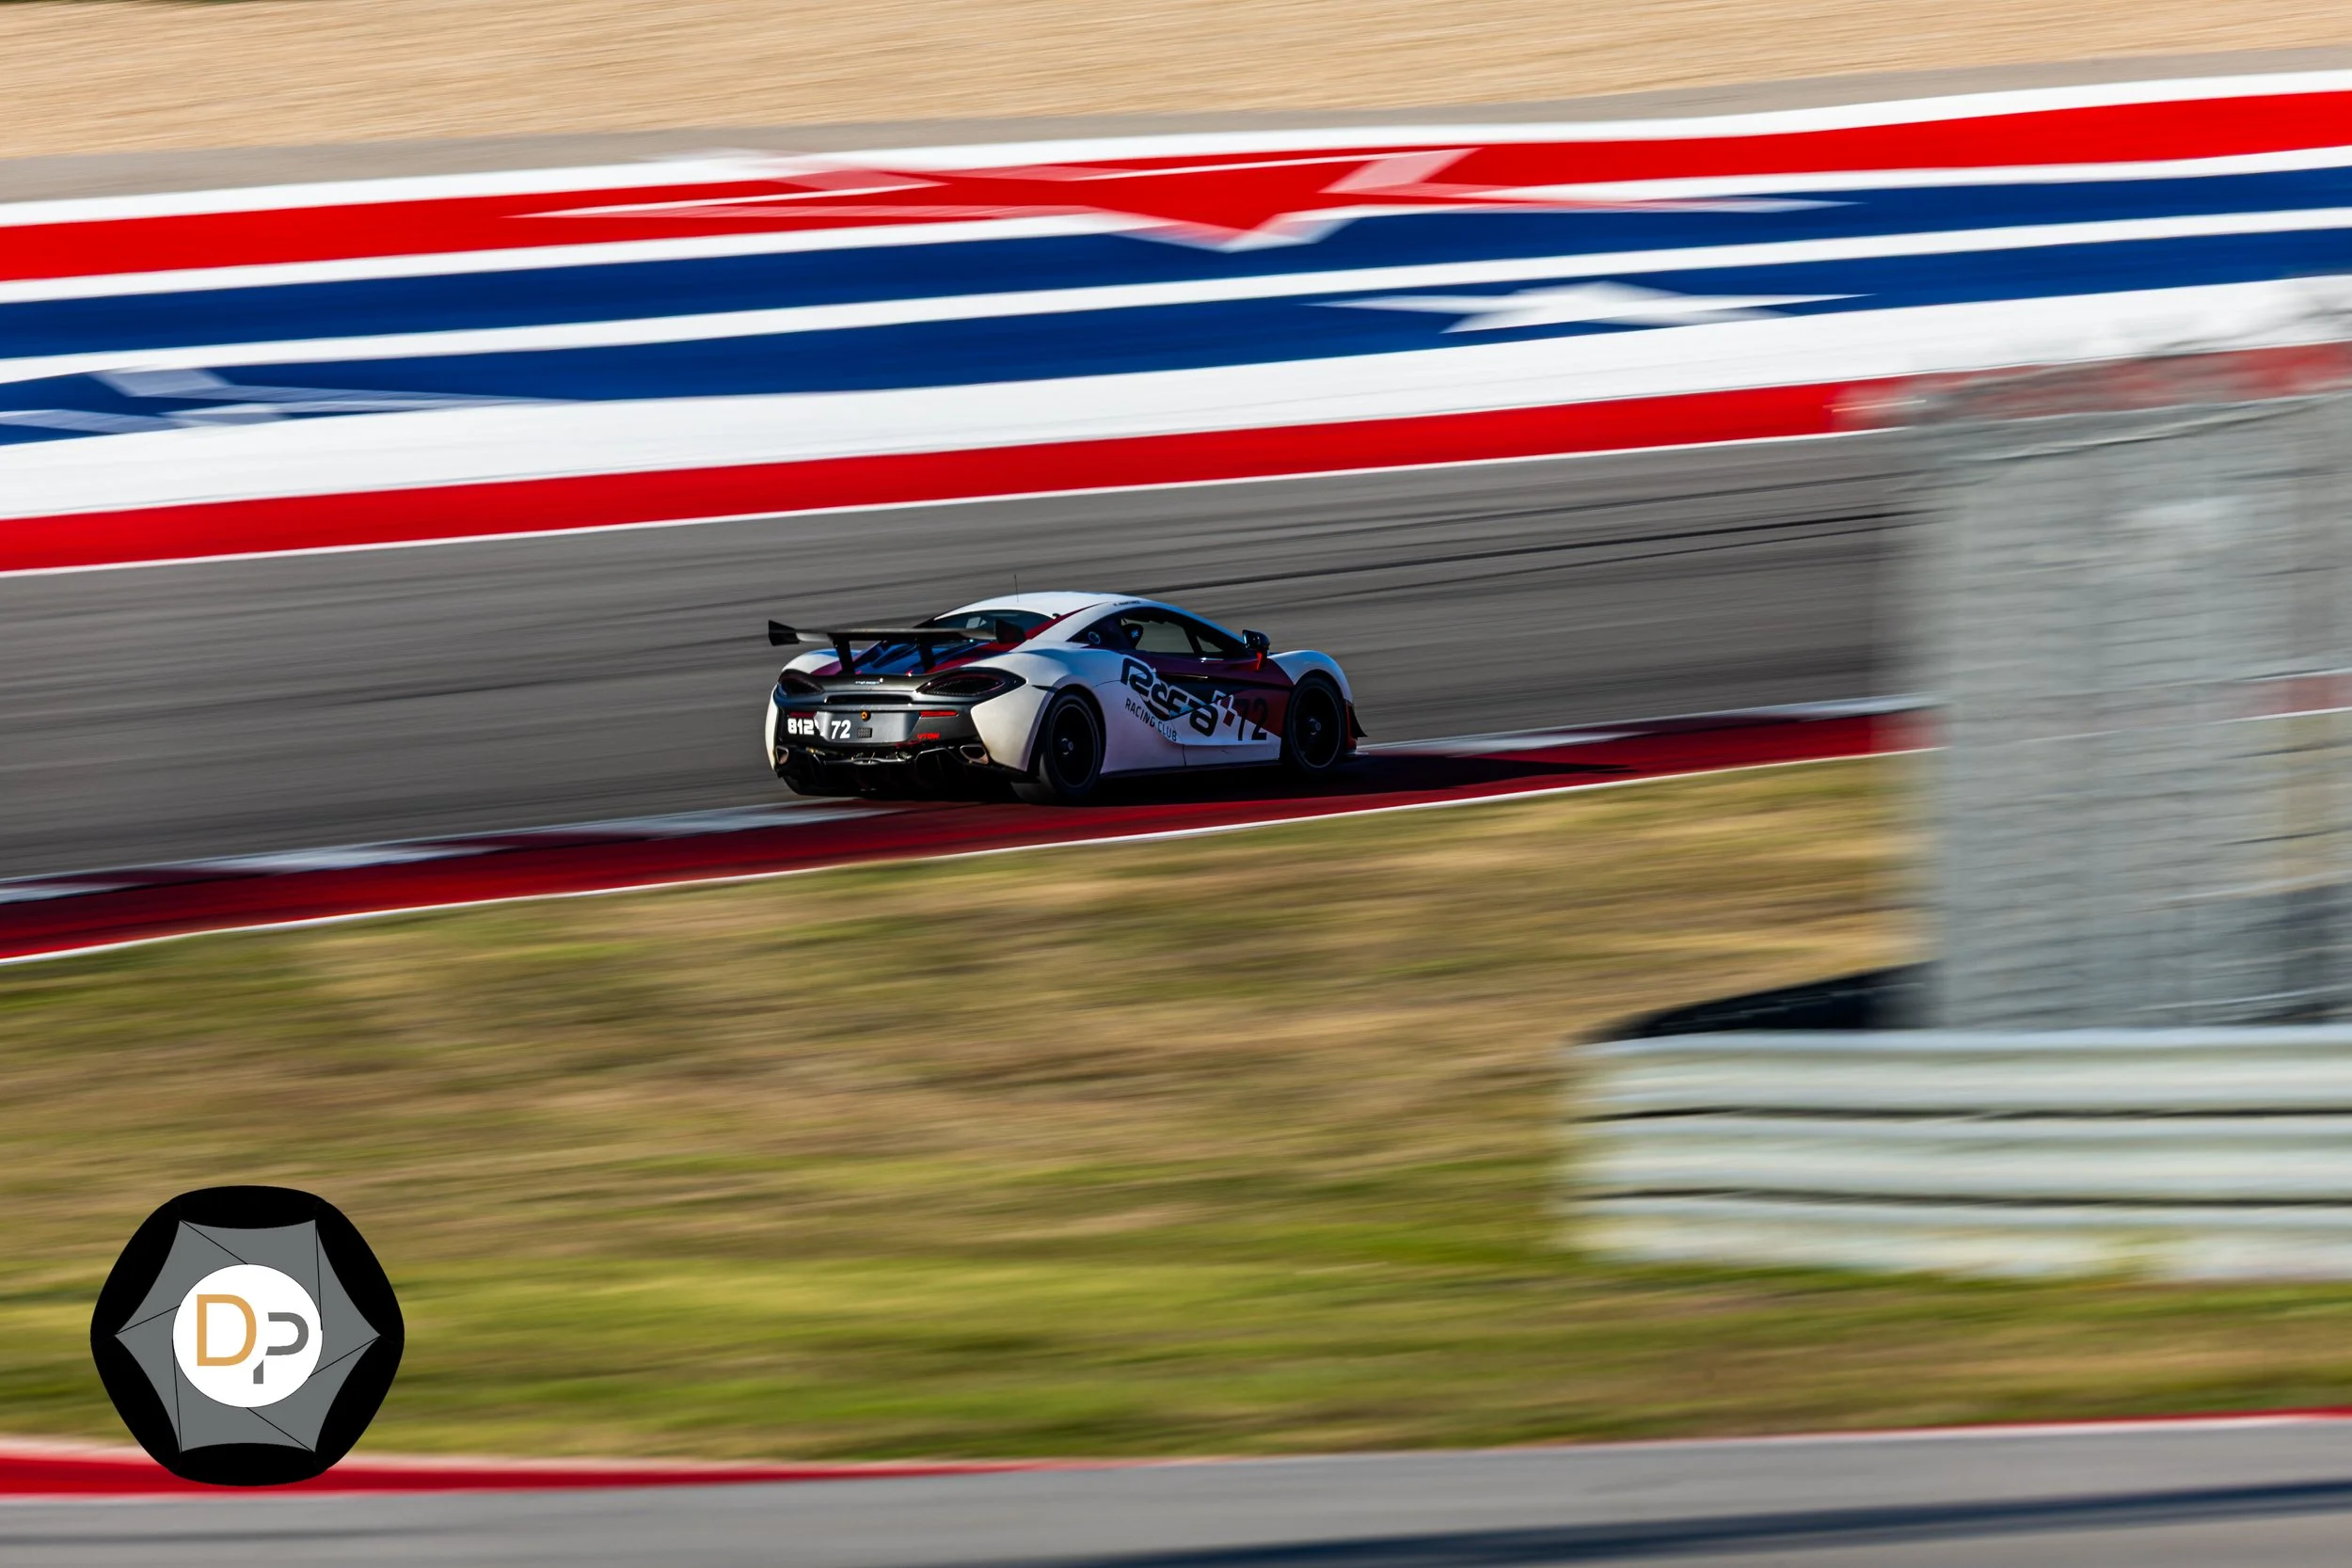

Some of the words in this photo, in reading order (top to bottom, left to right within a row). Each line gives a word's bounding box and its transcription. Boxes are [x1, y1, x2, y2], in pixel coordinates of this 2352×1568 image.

[832, 720, 851, 739] 72
[1125, 698, 1155, 728] RACING
[1157, 721, 1178, 741] CLUB
[1234, 697, 1267, 741] 72
